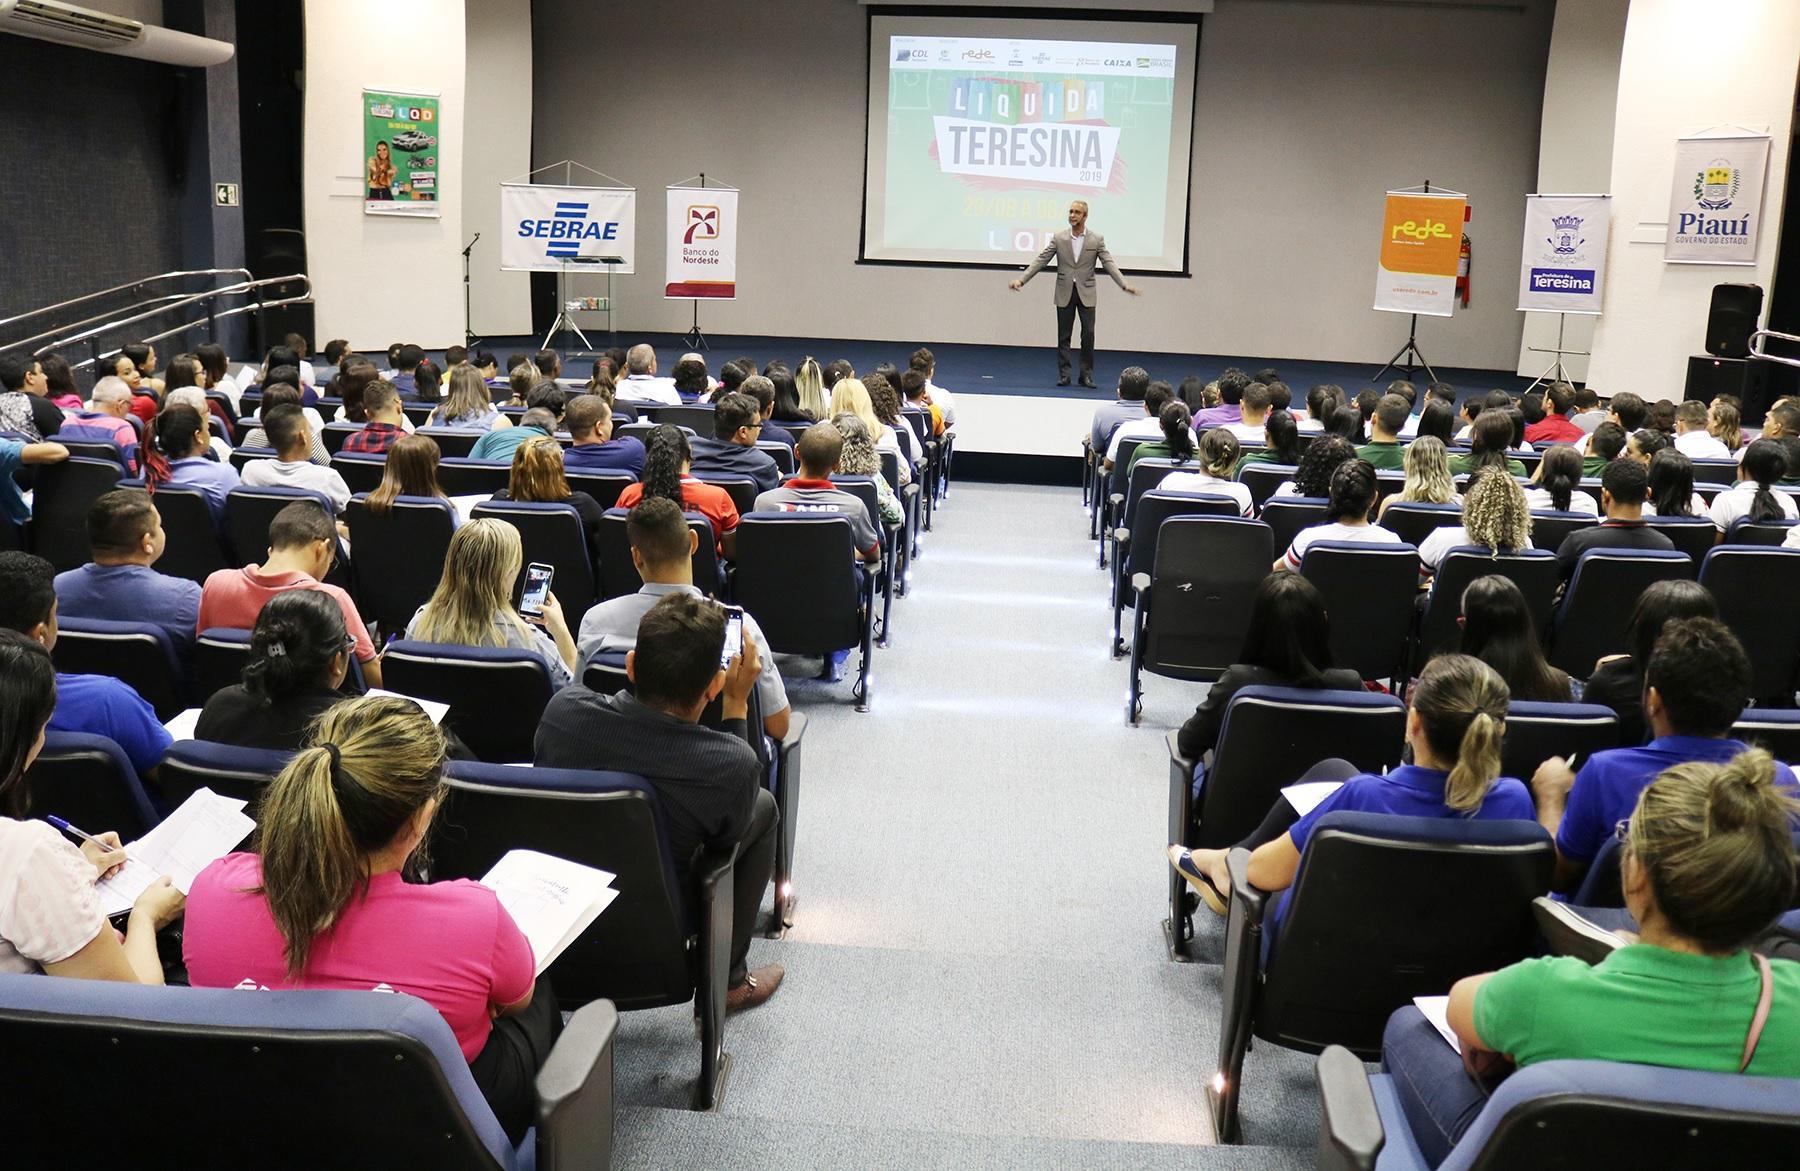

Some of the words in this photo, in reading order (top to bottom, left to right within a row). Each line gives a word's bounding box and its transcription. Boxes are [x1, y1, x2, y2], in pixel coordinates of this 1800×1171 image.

[911, 49, 929, 58] CDL
[961, 49, 996, 60] rede
[1103, 59, 1133, 67] CAIXA
[954, 87, 1098, 116] LIQUIDA
[399, 107, 433, 120] LQD
[948, 125, 1103, 170] TERESINA
[1079, 170, 1102, 182] 2019
[518, 219, 619, 240] SEBRAE
[1391, 219, 1453, 240] rede
[1676, 212, 1750, 236] Piauí
[1675, 236, 1707, 244] GOVERNO
[1720, 237, 1748, 245] ESTADO
[682, 247, 707, 256] Banco
[682, 256, 719, 264] Nordeste
[1533, 275, 1592, 290] Teresina
